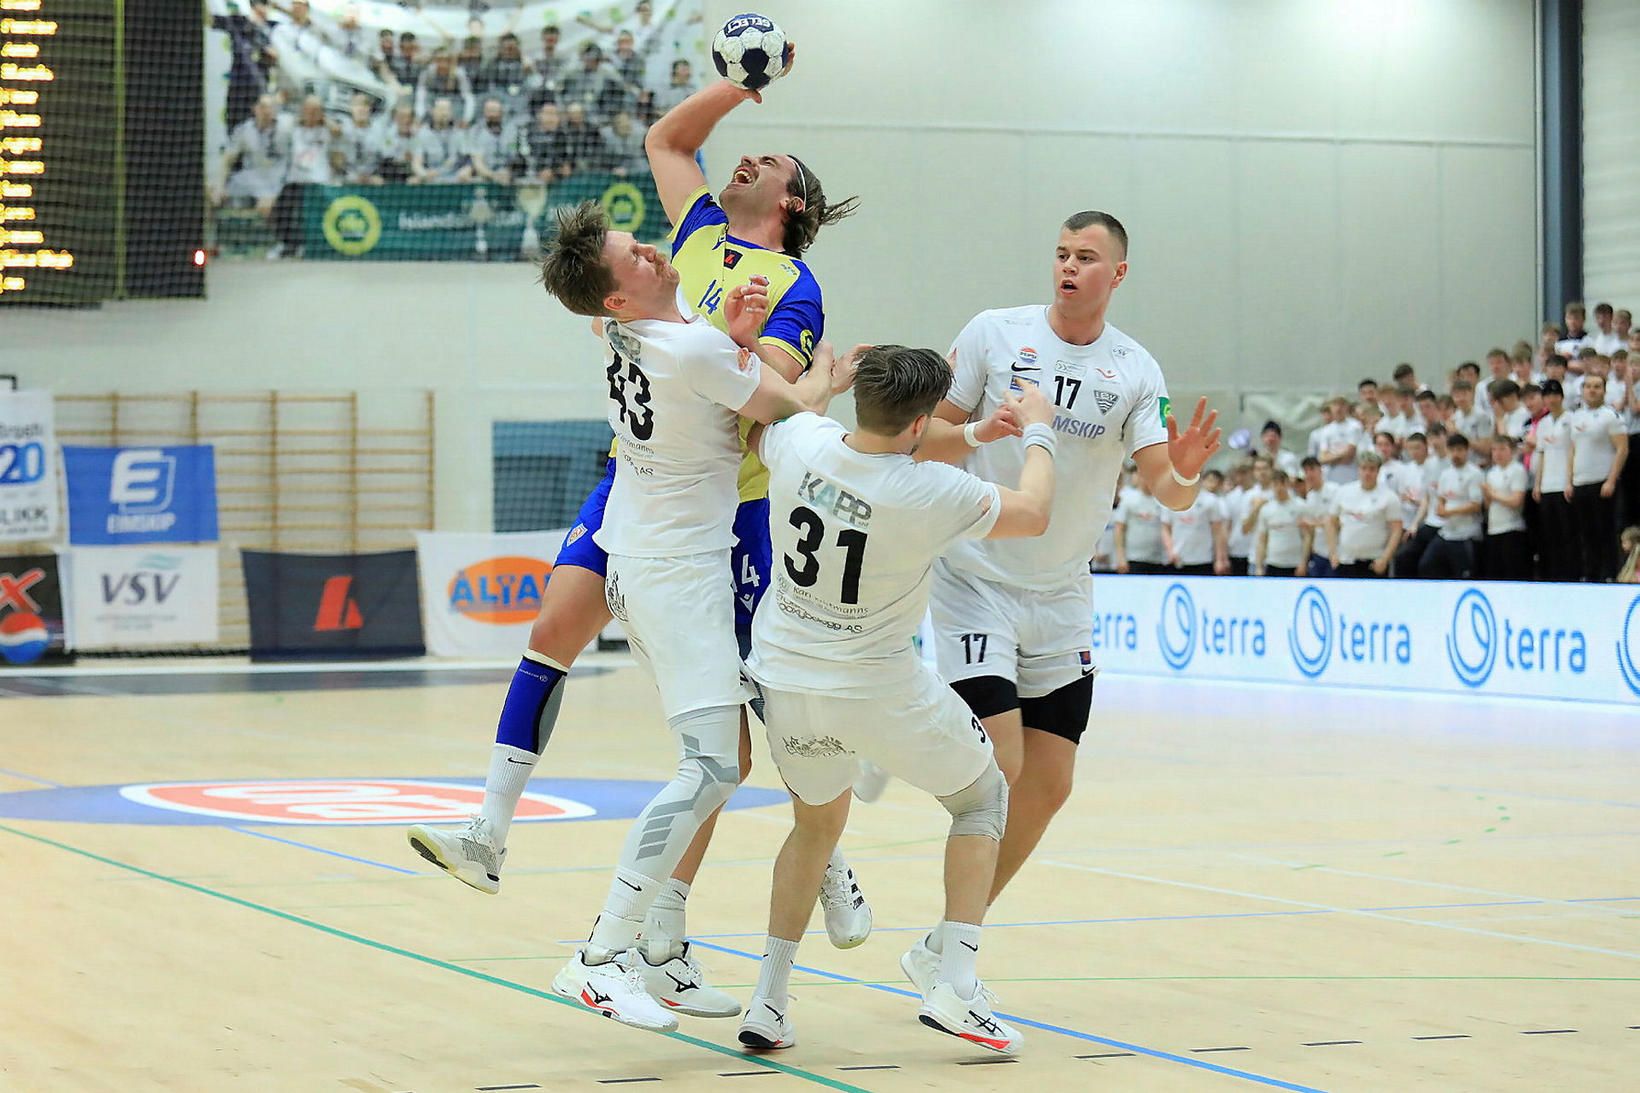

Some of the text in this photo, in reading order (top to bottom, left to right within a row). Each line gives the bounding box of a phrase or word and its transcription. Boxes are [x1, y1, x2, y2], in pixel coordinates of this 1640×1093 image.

[697, 279, 723, 315] 14
[1054, 375, 1082, 410] 17
[1052, 415, 1105, 439] MSKIP
[798, 471, 871, 525] KAPP
[741, 554, 760, 587] 4
[784, 506, 868, 605] 31
[101, 573, 180, 605] VSV
[960, 633, 987, 664] 17
[1092, 613, 1137, 650] erra
[1203, 609, 1266, 656] terra
[1340, 614, 1411, 665] terra
[1505, 618, 1587, 674] terra
[971, 716, 986, 743] 3
